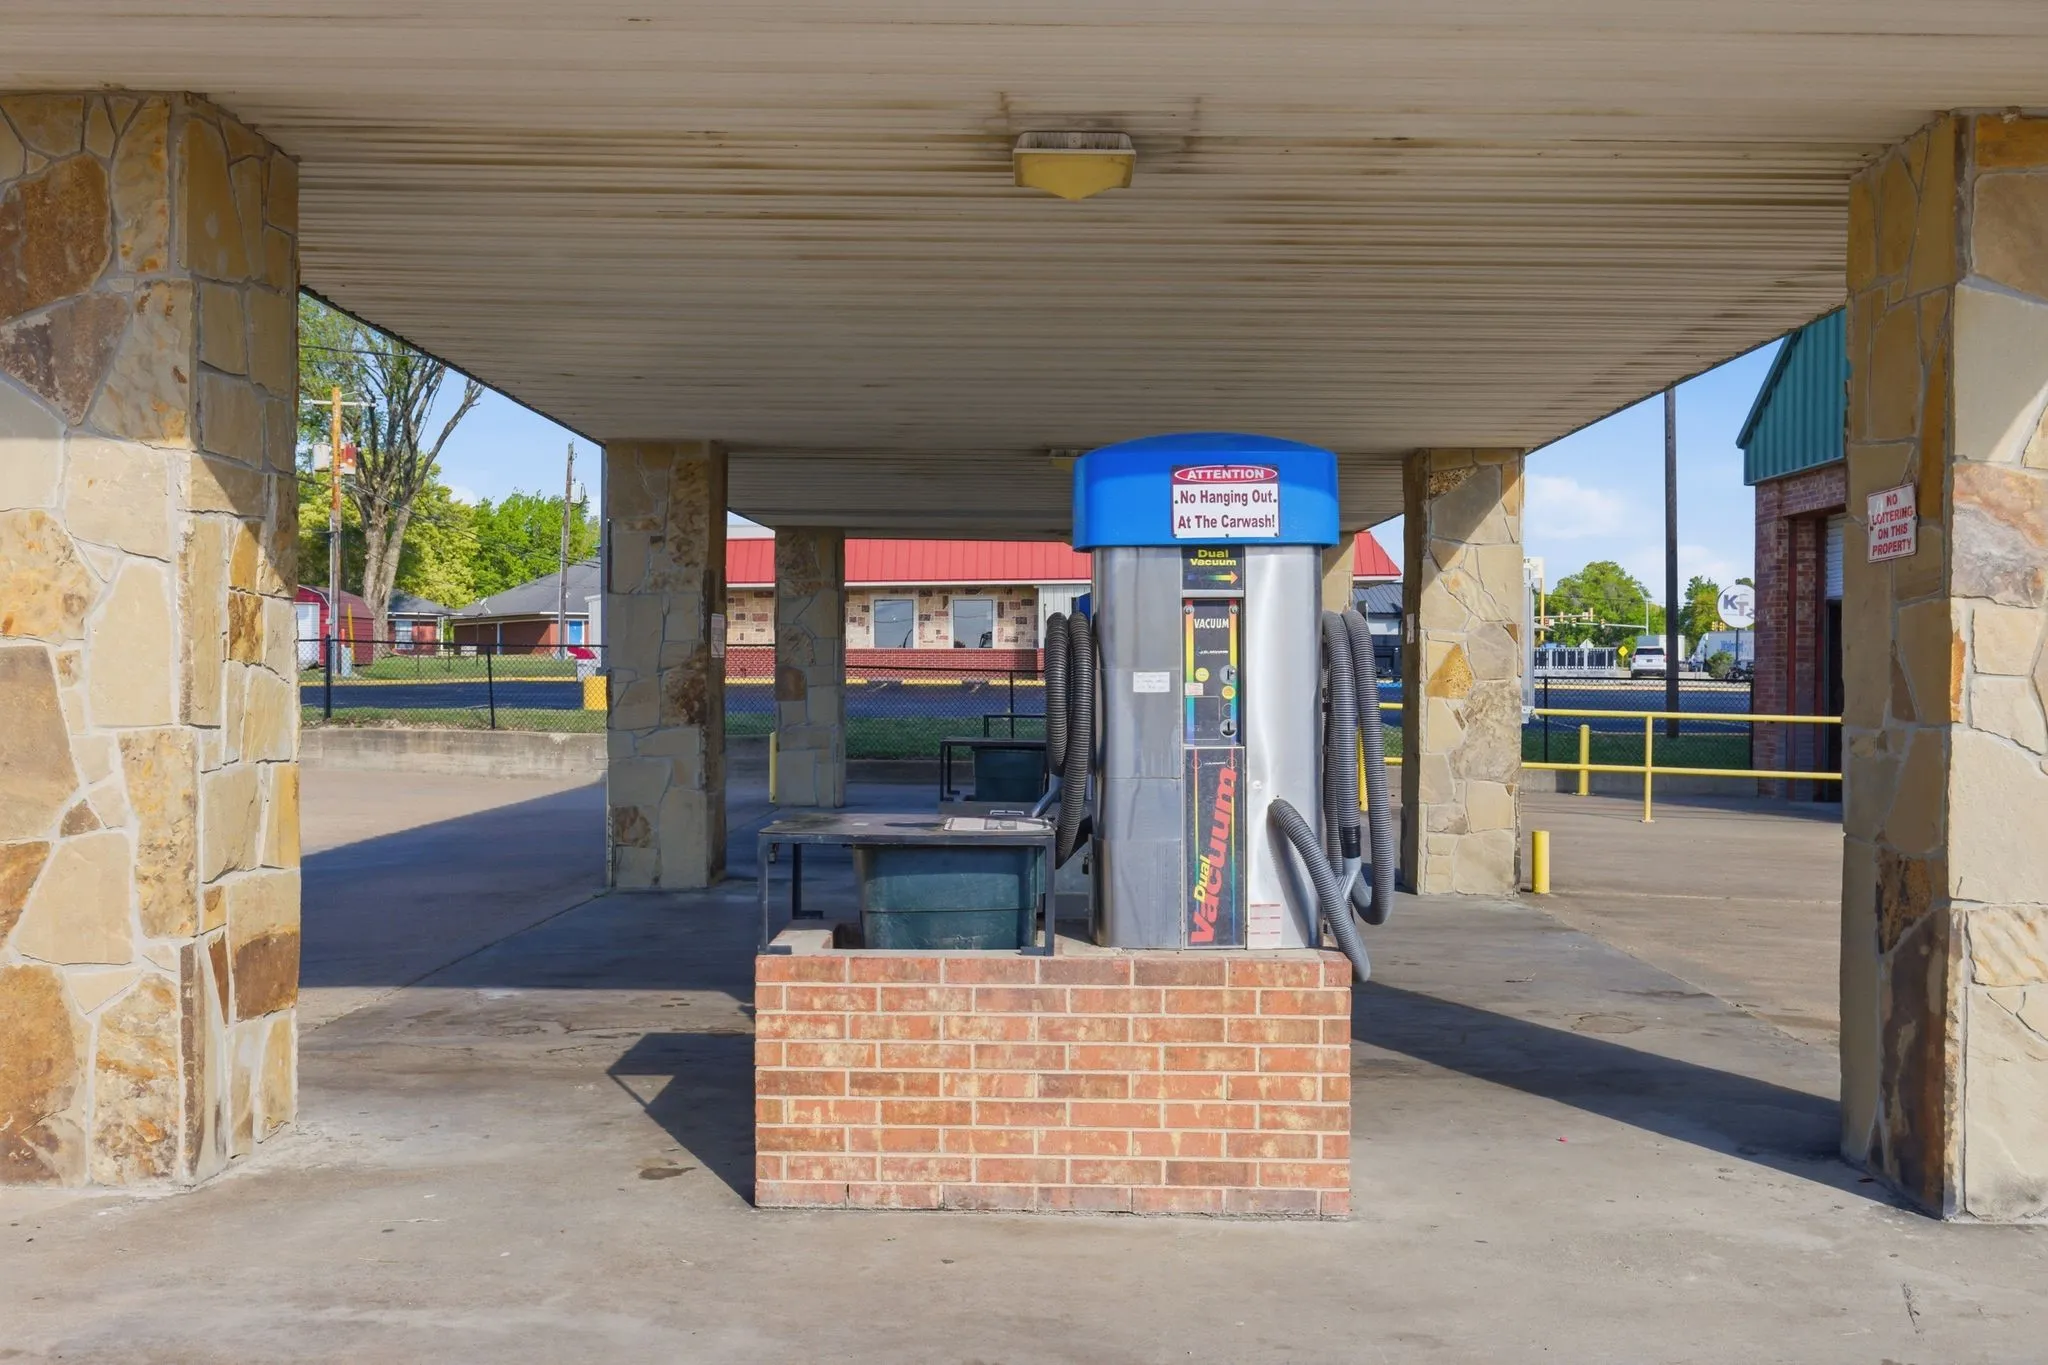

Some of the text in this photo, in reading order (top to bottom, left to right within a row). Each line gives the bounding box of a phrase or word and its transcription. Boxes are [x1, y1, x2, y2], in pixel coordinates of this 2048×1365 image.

[1187, 469, 1265, 480] ATTENTION
[1180, 490, 1196, 504] No
[1200, 490, 1248, 507] Hanging
[1886, 494, 1898, 507] NO
[1178, 514, 1275, 529] At The Carwash!
[1872, 506, 1913, 525] LOITERING
[1878, 523, 1908, 540] ON THIS
[1197, 549, 1229, 558] Dual
[1872, 537, 1912, 556] PROPERTY
[1190, 558, 1237, 566] Vacuum
[1194, 618, 1230, 629] VACUUM
[1191, 767, 1237, 944] Vacuum
[1193, 854, 1211, 903] Dual
